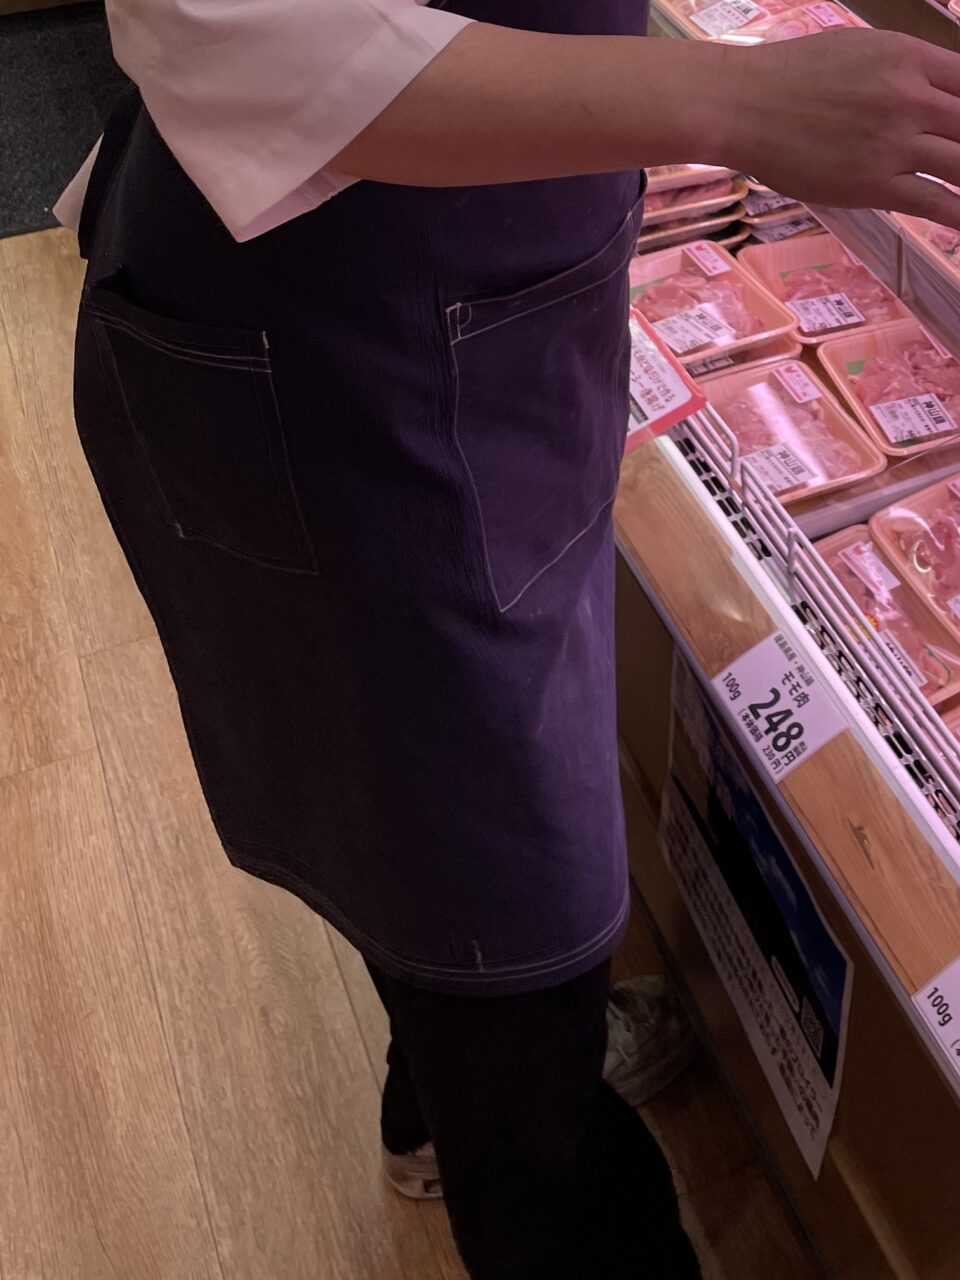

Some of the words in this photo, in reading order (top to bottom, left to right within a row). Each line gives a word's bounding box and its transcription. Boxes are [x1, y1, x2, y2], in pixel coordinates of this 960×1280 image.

[722, 672, 742, 701] 100g
[781, 670, 811, 709] モモ肉
[747, 686, 804, 753] 248
[926, 987, 953, 1027] 100g
